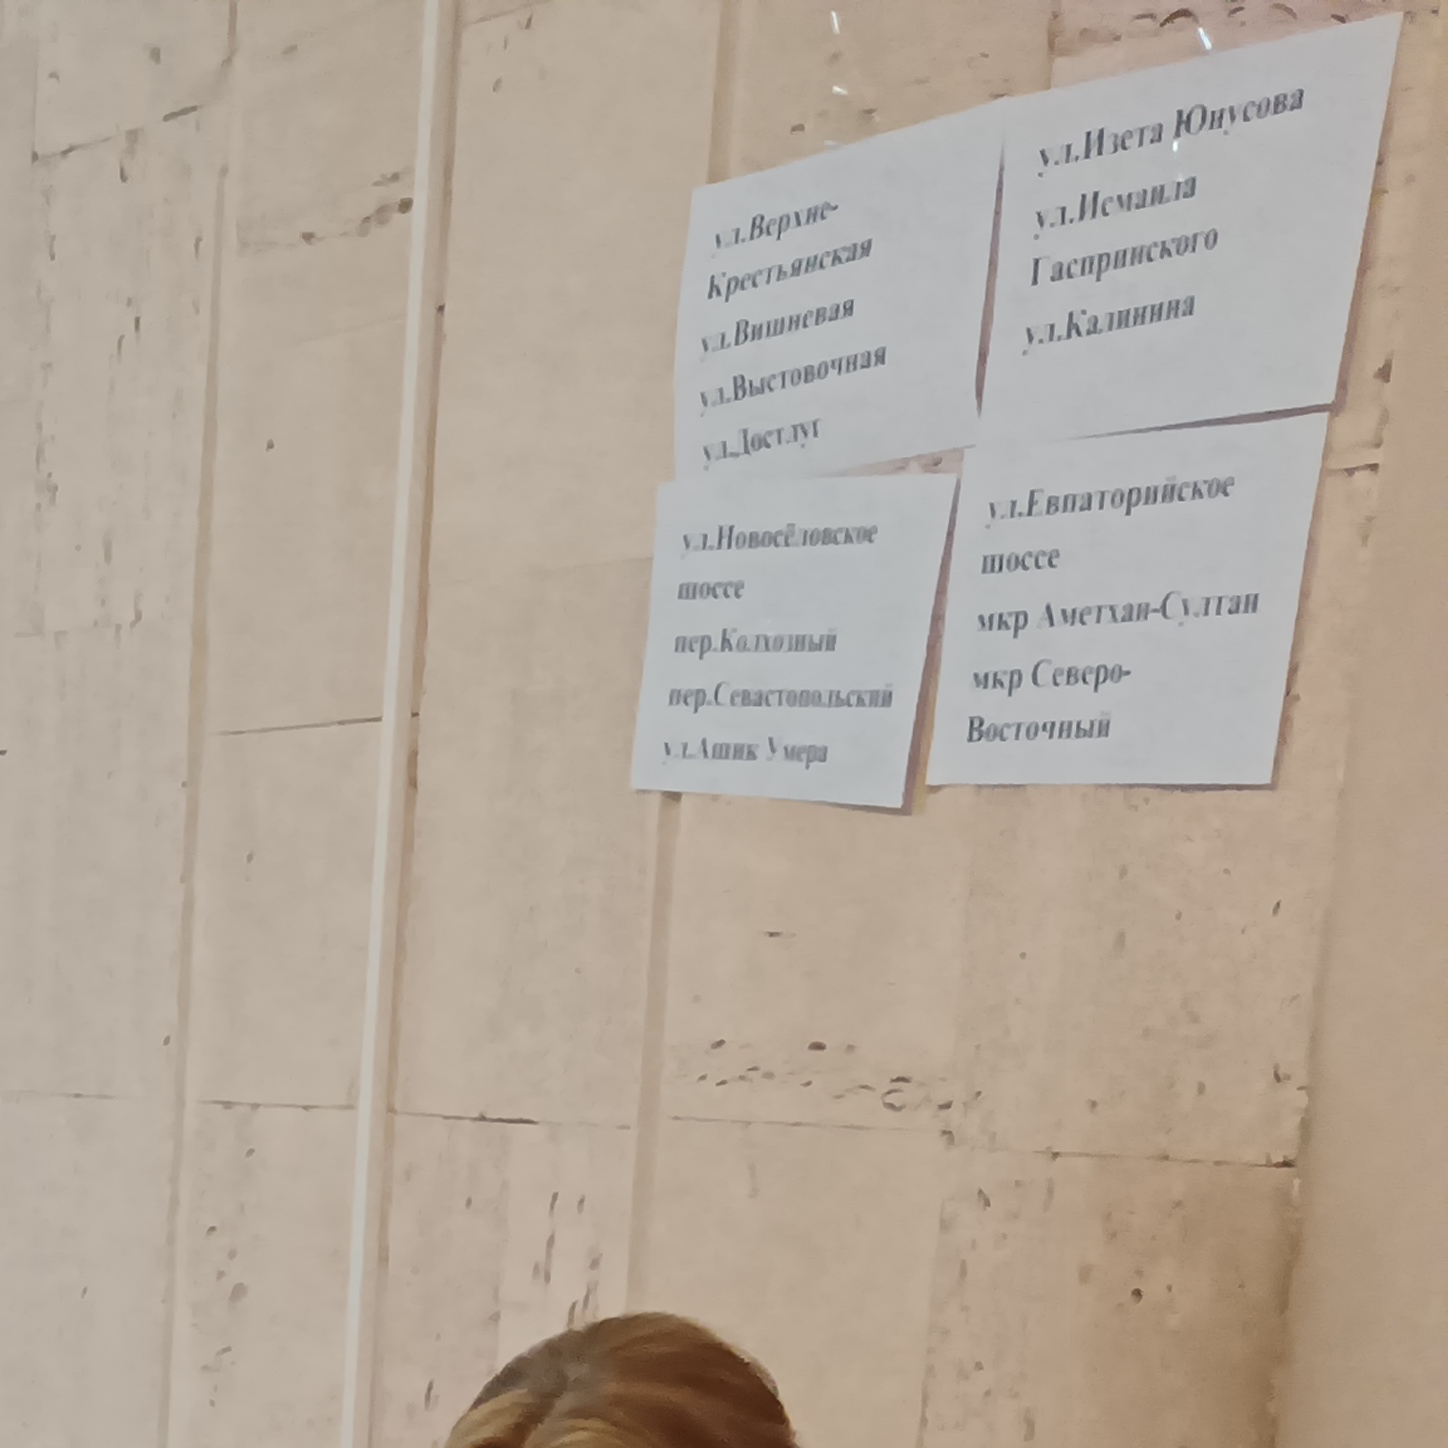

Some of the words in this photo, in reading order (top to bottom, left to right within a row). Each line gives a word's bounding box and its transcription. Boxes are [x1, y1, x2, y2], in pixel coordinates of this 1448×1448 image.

[1038, 122, 1163, 178] ул.Изета
[1173, 88, 1304, 139] Юнусова
[1033, 176, 1197, 240] ул.Исмаила
[708, 238, 873, 302] Крестьянская
[1031, 228, 1219, 286] Гаспринского
[700, 299, 855, 363] ул.Вишневая
[1022, 295, 1195, 356] ул.Калинина
[700, 346, 887, 417] ул.Выстовочная
[985, 475, 1235, 530] ул.Евпаторийское
[981, 548, 1061, 575] шоссе
[677, 580, 745, 600] шоссе
[673, 628, 838, 661] пер.Колхозный
[976, 609, 1029, 639] мкр
[972, 667, 1023, 697] мкр
[1031, 658, 1131, 694] Северо-
[966, 710, 1112, 743] Восточный
